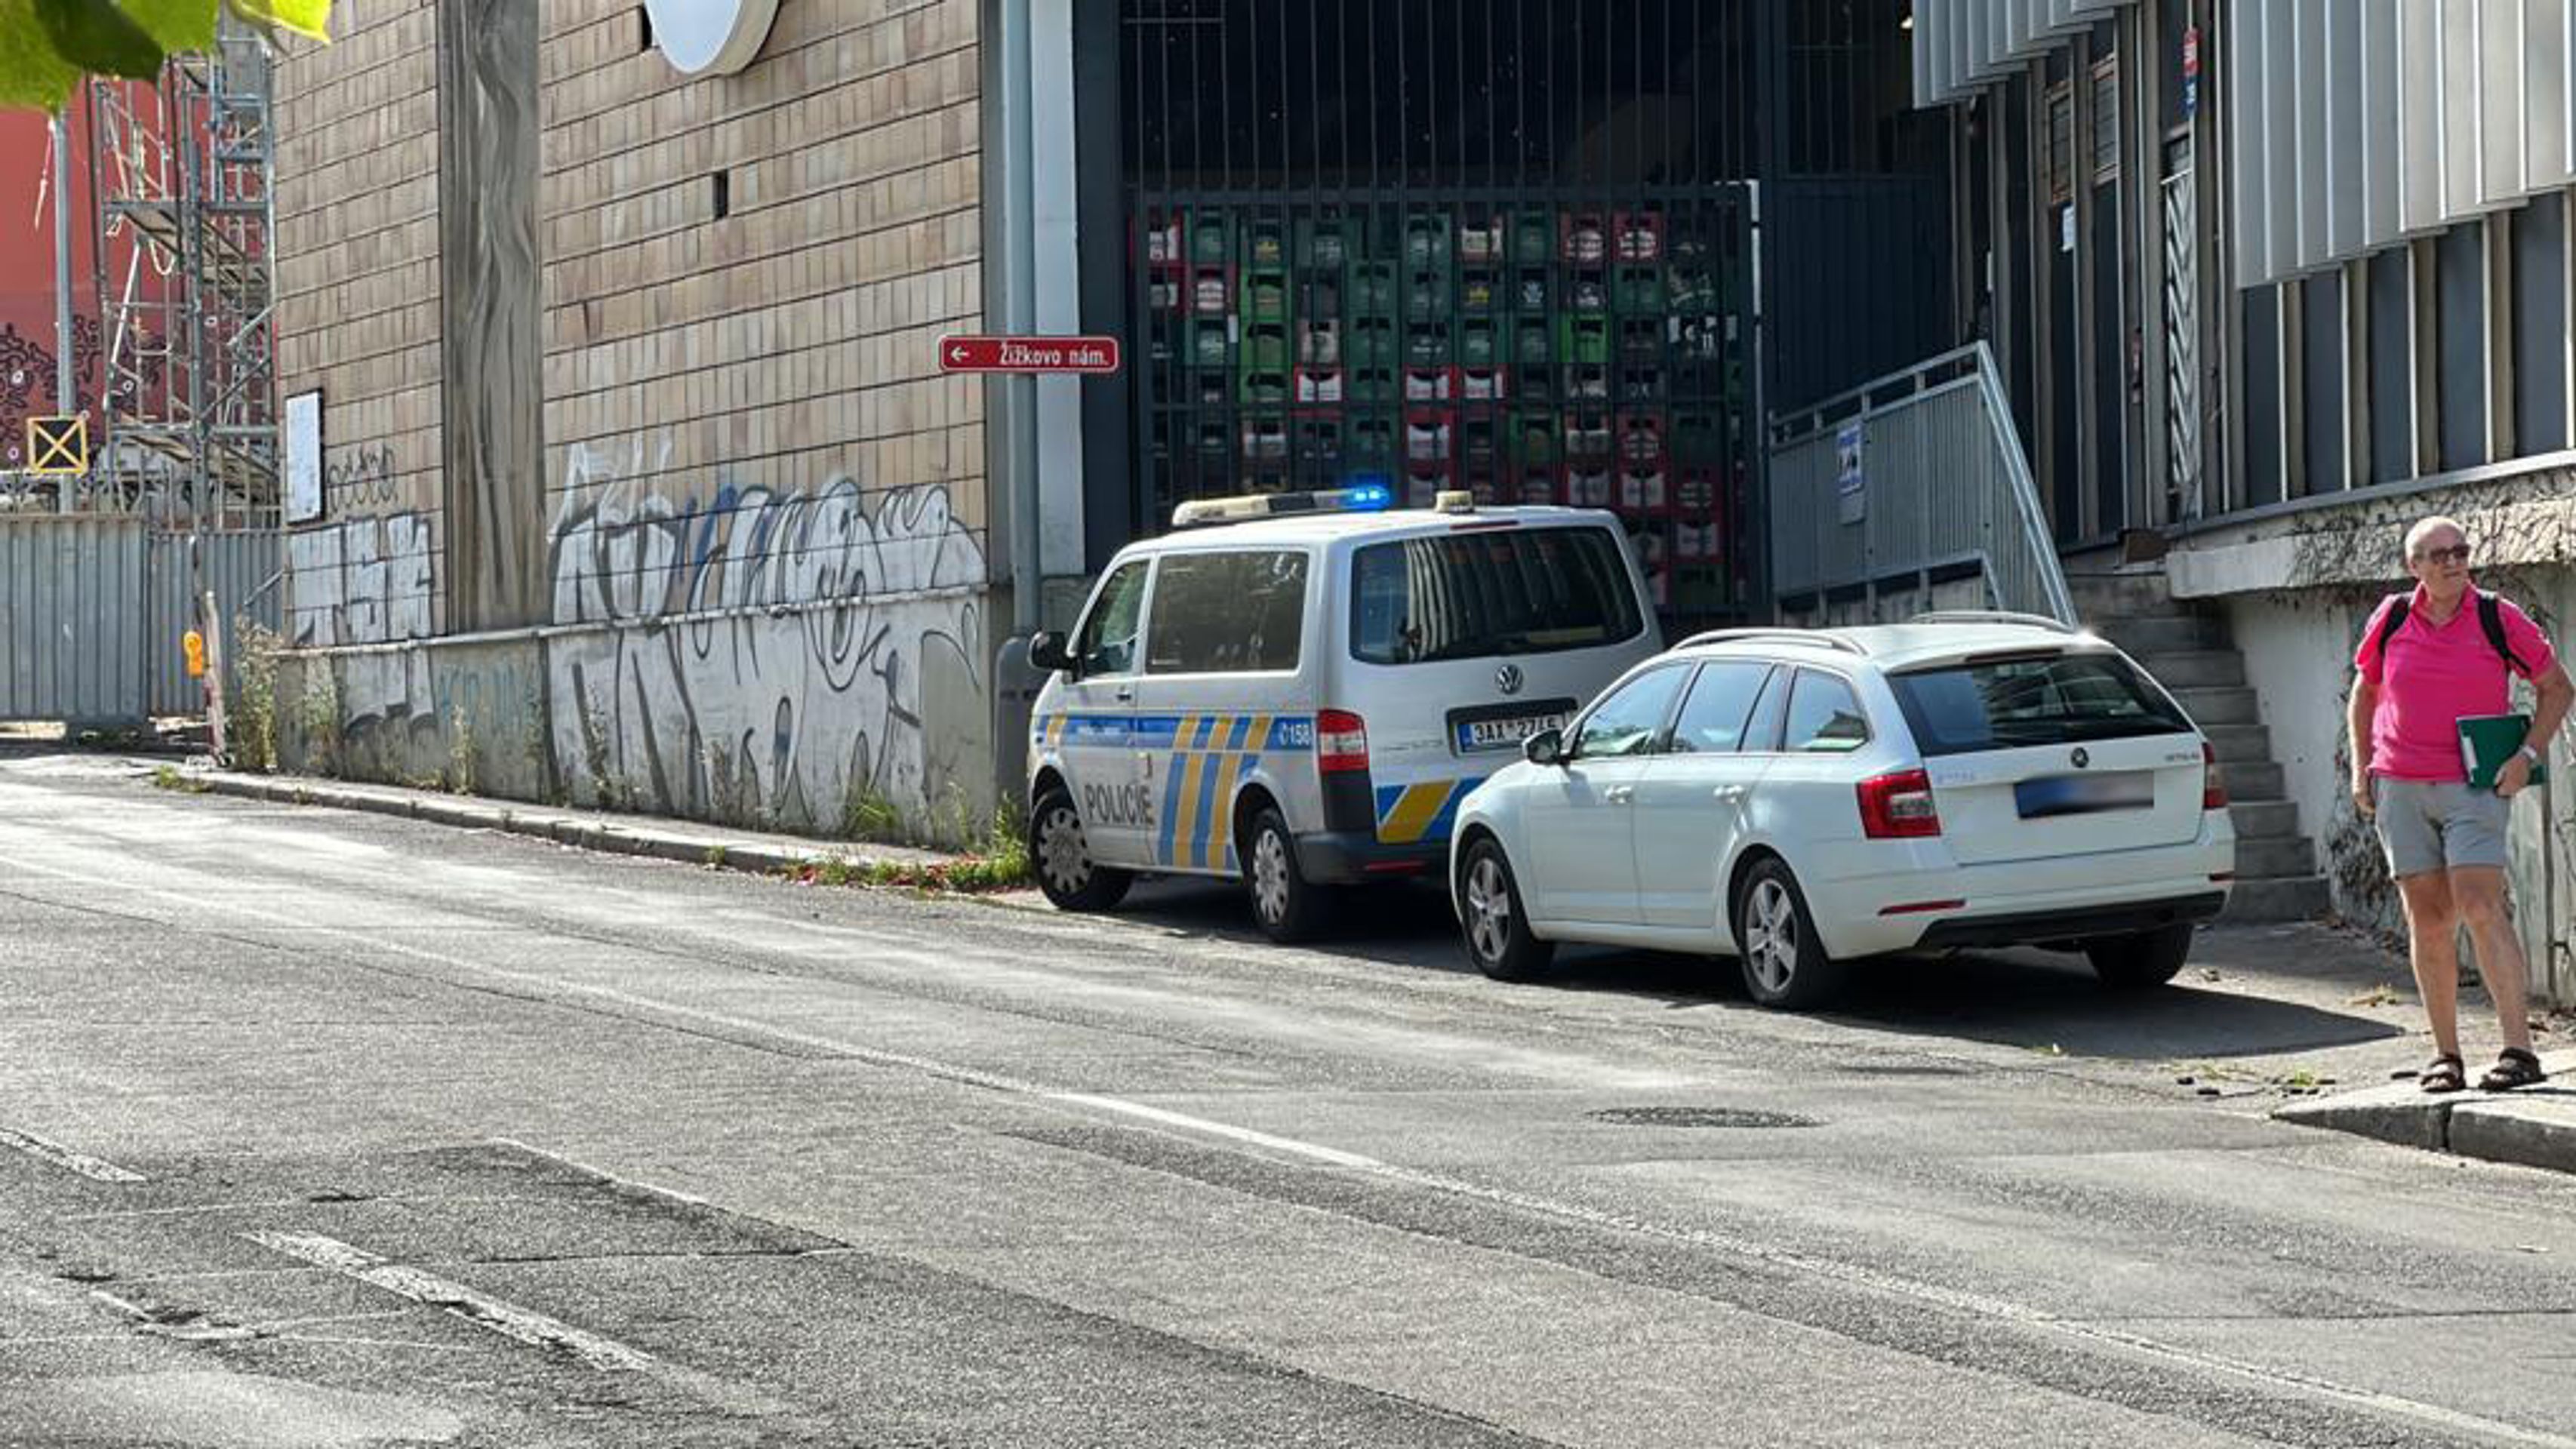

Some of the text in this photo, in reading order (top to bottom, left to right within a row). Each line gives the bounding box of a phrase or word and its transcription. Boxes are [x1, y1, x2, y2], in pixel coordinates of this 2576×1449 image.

[999, 341, 1109, 366] Žižkovo nám.
[1290, 723, 1310, 746] 158
[1474, 722, 1505, 744] 3AX
[1084, 784, 1155, 826] POLICIE
